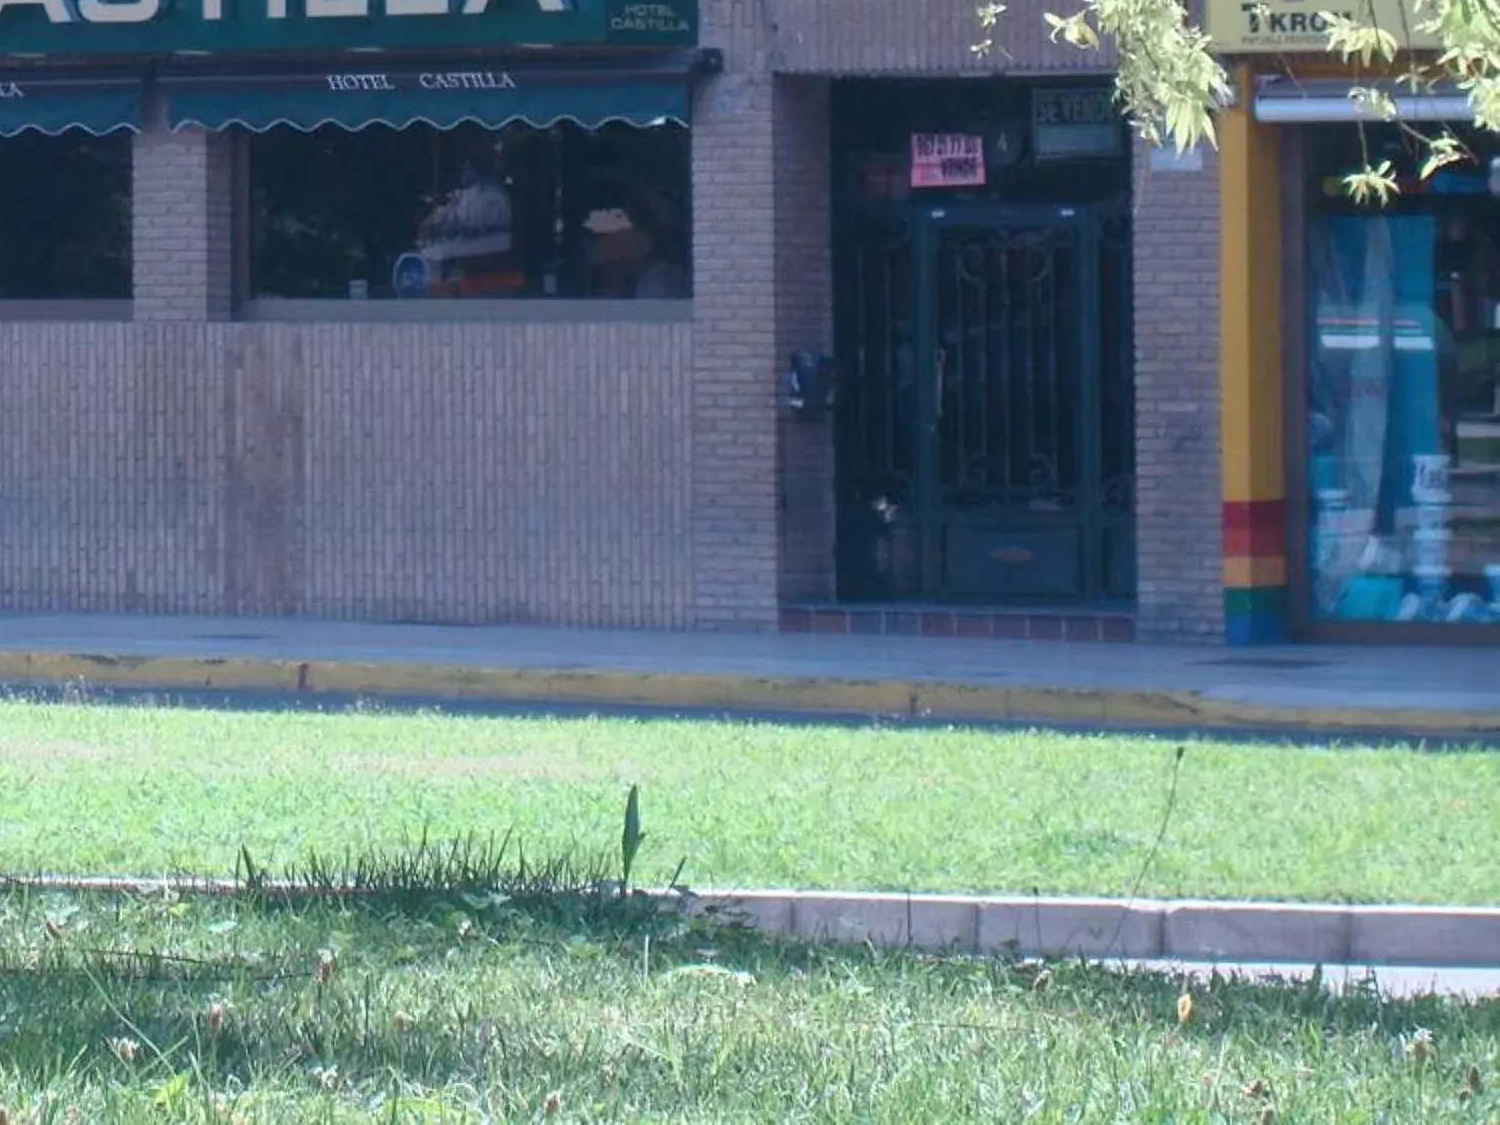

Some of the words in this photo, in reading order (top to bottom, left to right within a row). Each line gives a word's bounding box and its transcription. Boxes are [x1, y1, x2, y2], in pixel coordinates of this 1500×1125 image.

[610, 16, 691, 31] CASTILLA
[327, 74, 396, 91] HOTEL
[419, 72, 516, 90] CASTILLA
